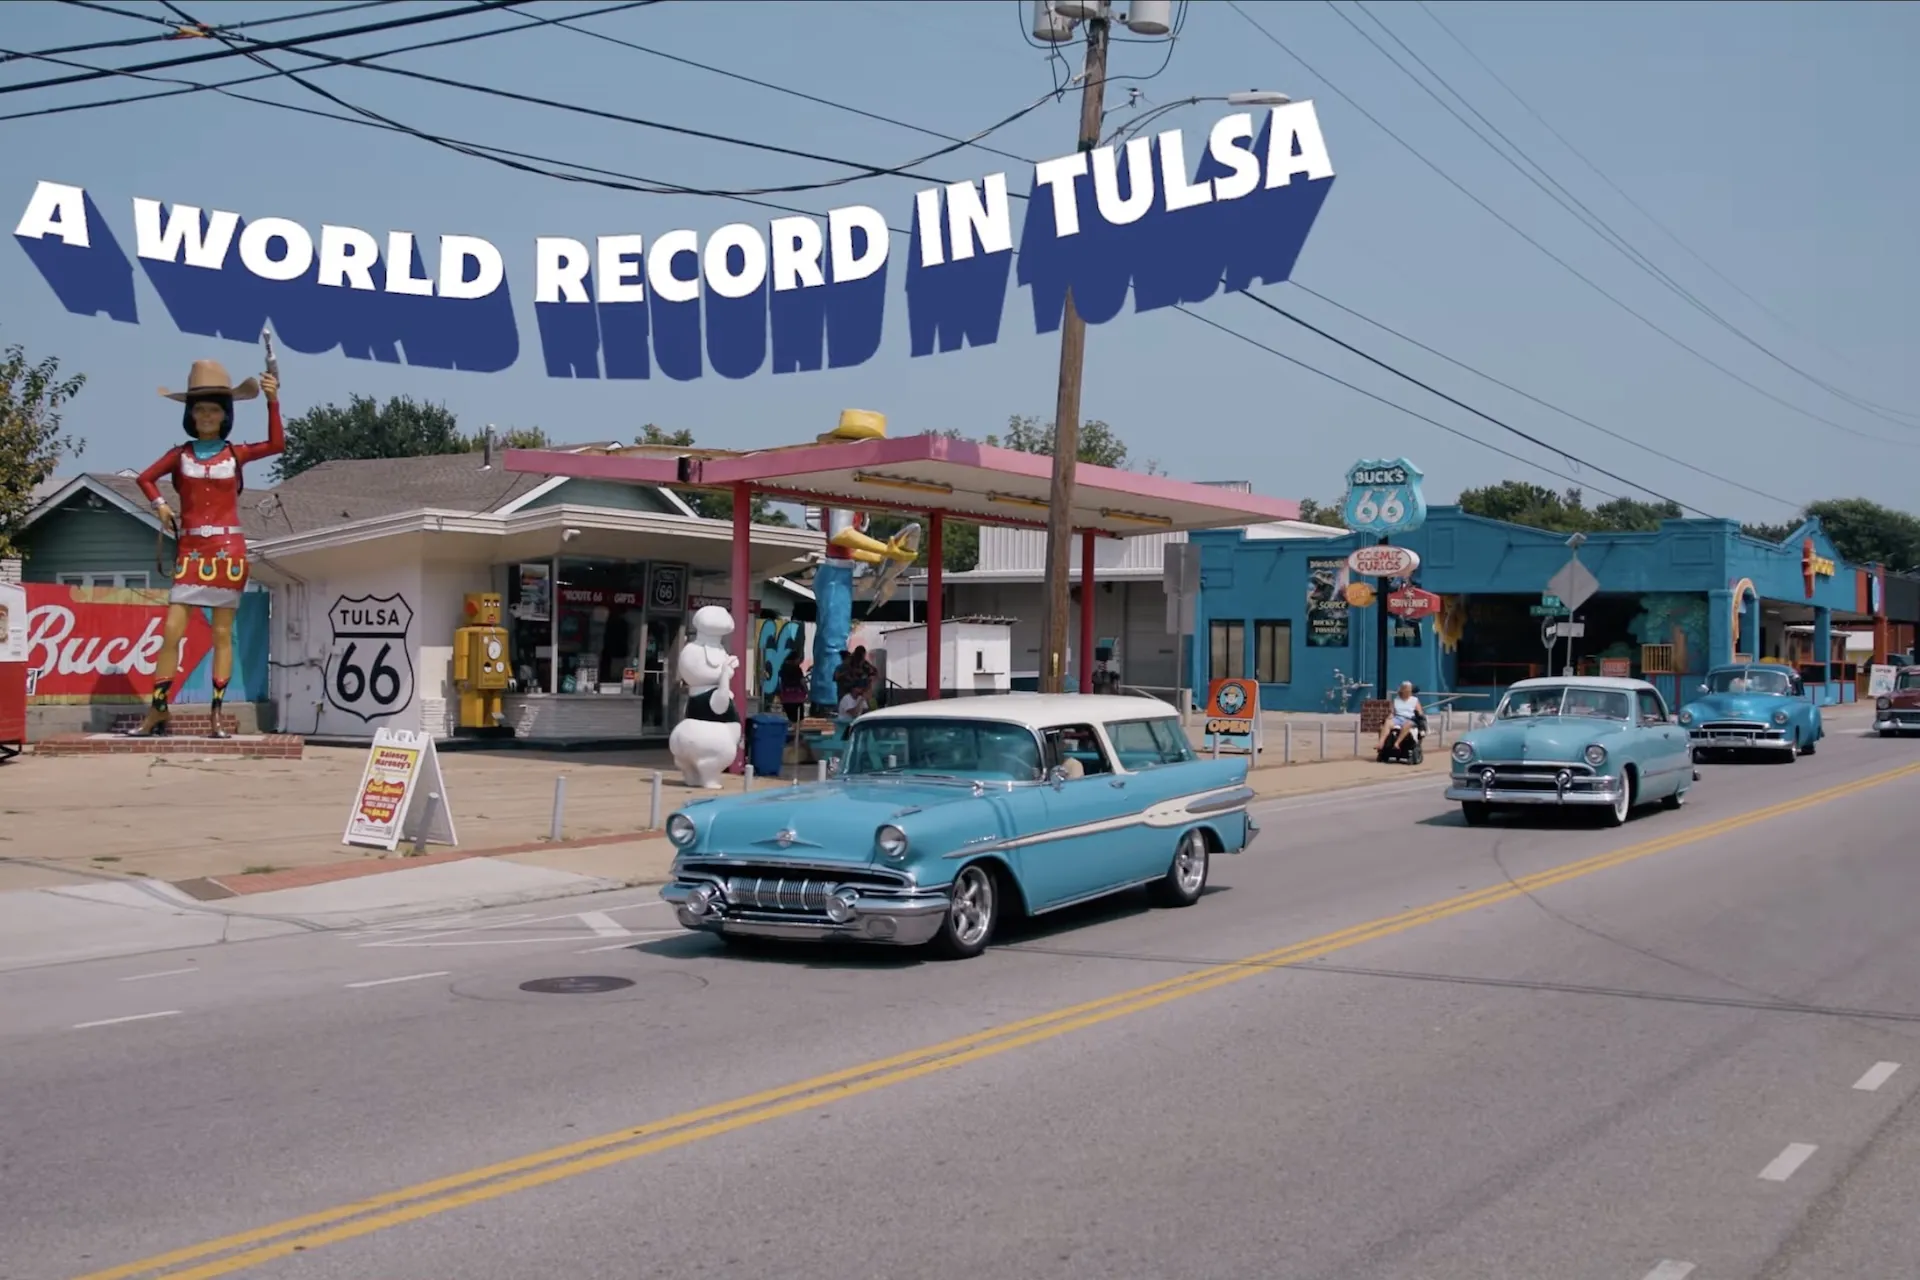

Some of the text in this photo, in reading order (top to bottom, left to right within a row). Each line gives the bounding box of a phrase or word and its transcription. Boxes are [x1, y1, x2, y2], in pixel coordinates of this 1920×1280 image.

[1355, 468, 1405, 484] BUCK'S
[1356, 488, 1405, 524] 66
[1356, 550, 1402, 560] COSMIC
[1356, 561, 1402, 571] CURIOS
[593, 592, 603, 602] 66
[659, 585, 673, 599] 66
[340, 609, 399, 626] TULSA
[28, 604, 188, 680] Buck
[337, 642, 401, 705] 66
[1207, 719, 1250, 733] OPEN
